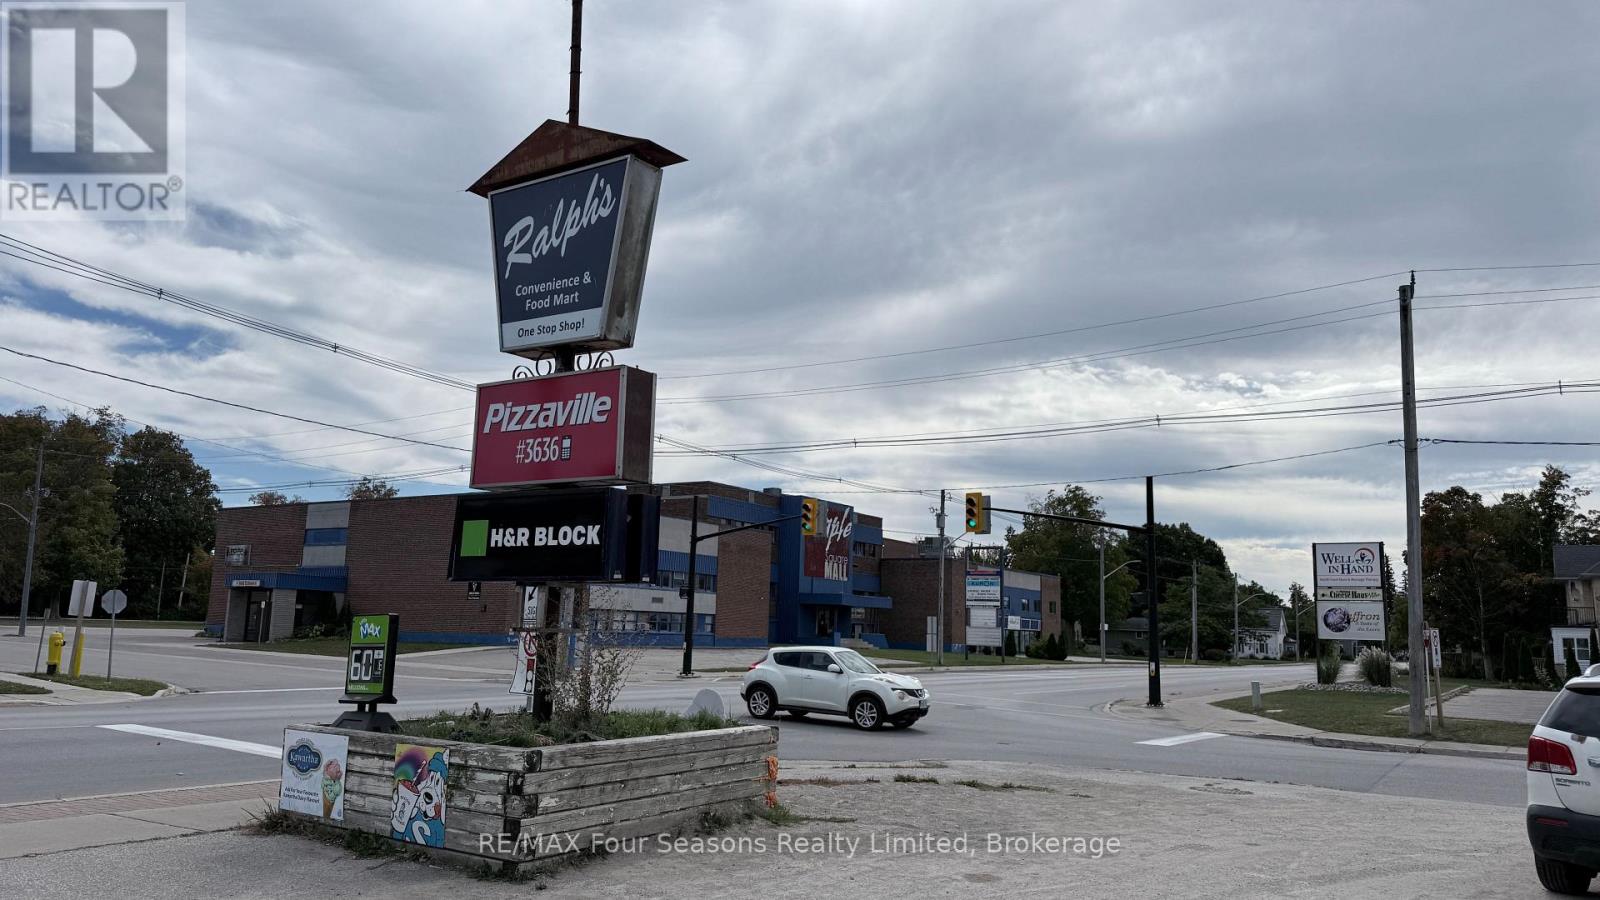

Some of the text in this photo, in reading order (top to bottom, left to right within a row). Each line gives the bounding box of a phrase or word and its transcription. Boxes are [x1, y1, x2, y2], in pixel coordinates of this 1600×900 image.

[503, 172, 616, 280] Ralph's
[515, 271, 592, 297] Convenience &
[525, 290, 580, 311] Food Mart
[517, 317, 585, 338] One Stop Shop!
[483, 391, 612, 434] Pizzaville
[515, 435, 559, 464] #3636
[490, 524, 601, 548] H&R BLOCK
[825, 560, 848, 581] MALL
